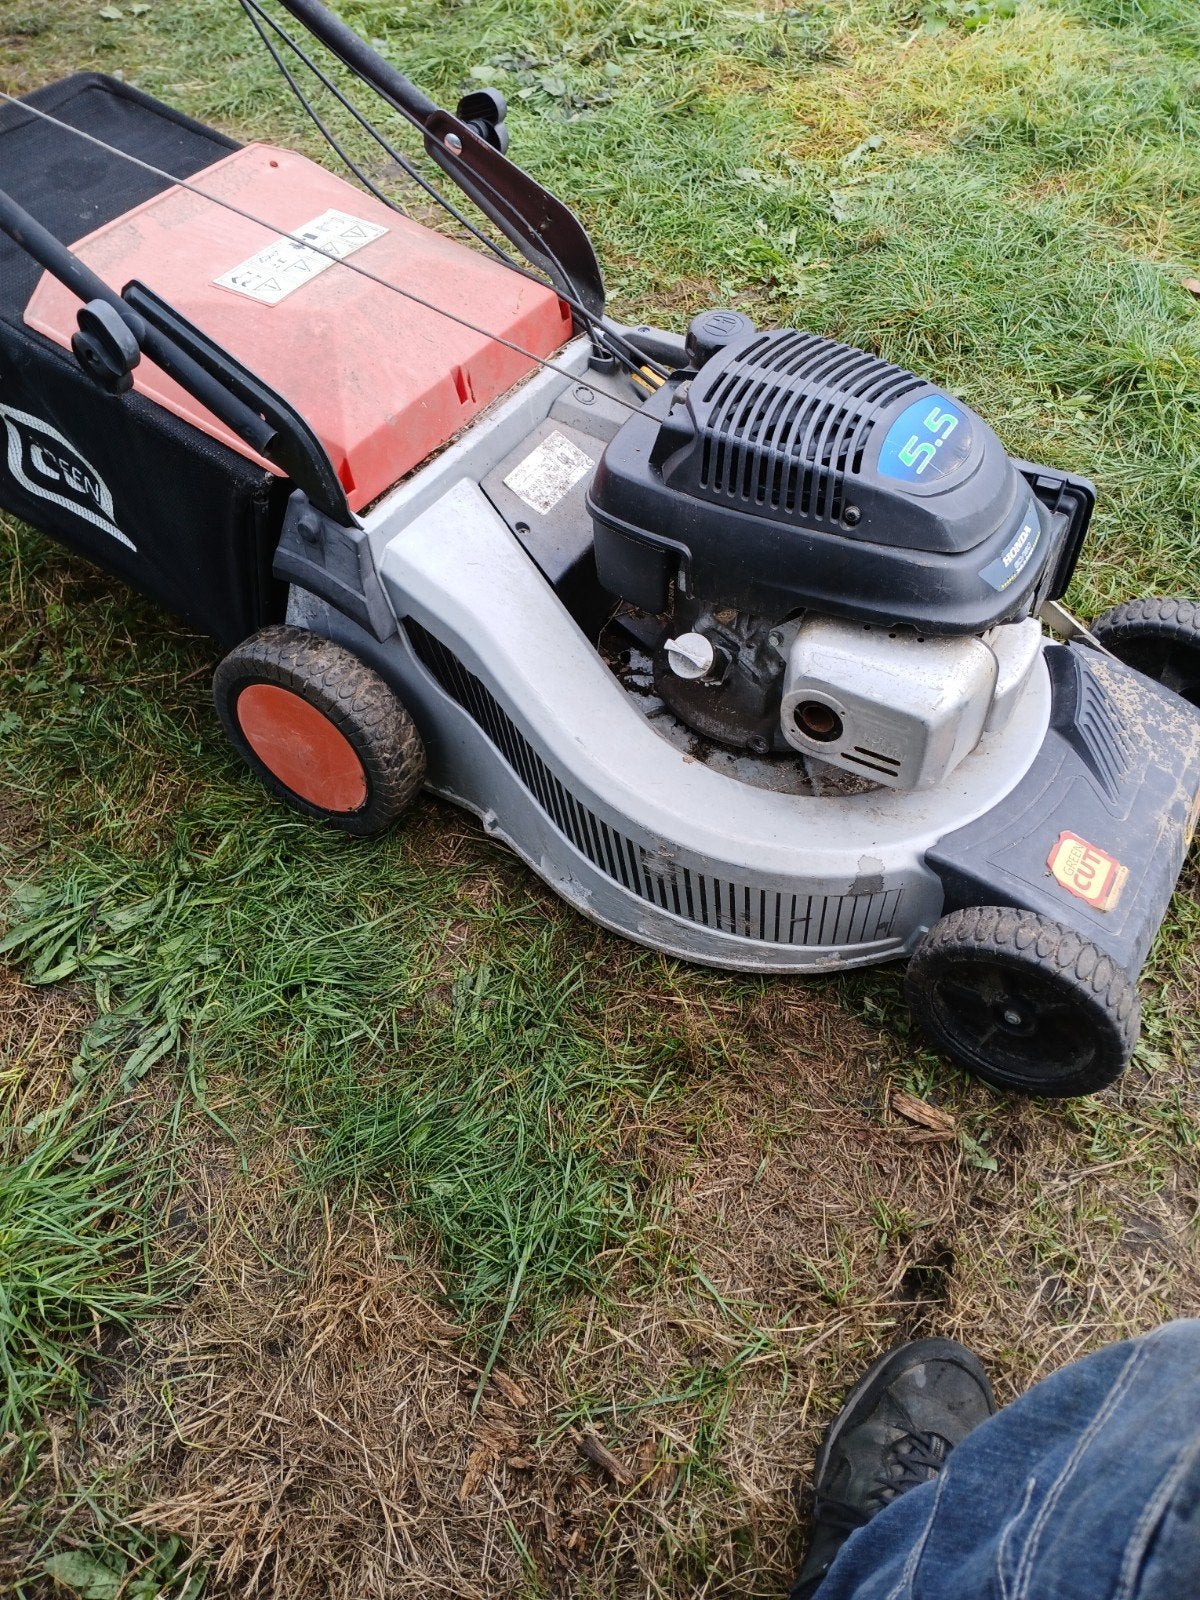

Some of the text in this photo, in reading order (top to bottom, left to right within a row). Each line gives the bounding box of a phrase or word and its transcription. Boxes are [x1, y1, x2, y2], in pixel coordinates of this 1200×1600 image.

[898, 407, 959, 475] 5.5
[1002, 525, 1032, 568] HONDA
[1063, 844, 1085, 876] GREEN
[1073, 848, 1102, 891] CUT
